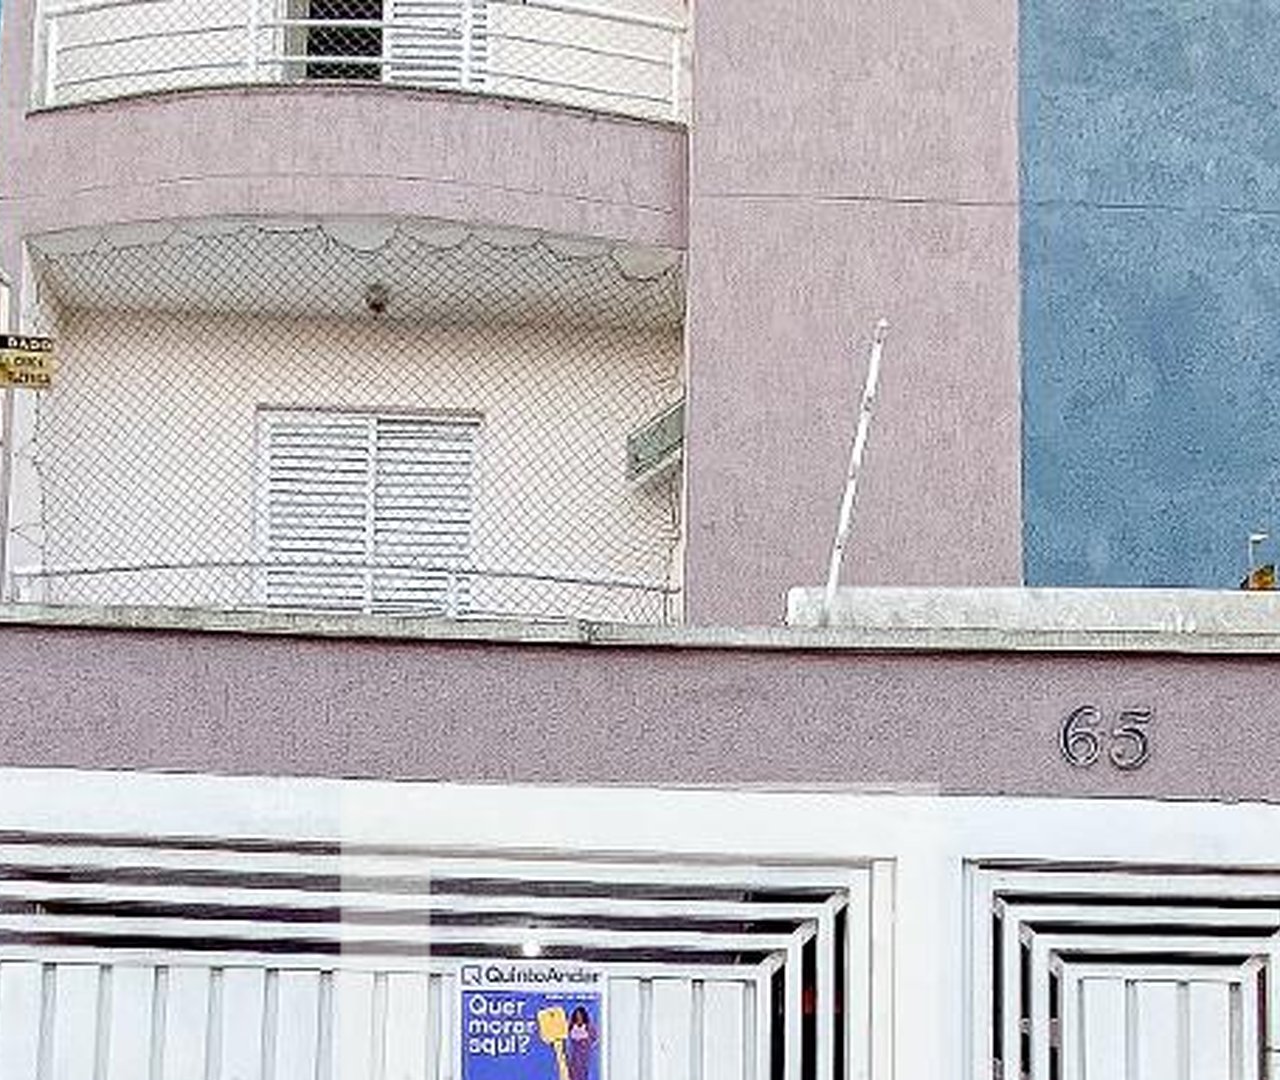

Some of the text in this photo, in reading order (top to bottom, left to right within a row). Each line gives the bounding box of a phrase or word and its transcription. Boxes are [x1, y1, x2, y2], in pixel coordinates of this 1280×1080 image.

[1059, 705, 1152, 770] 65
[485, 966, 600, 984] QuintoAndar
[469, 994, 526, 1015] Quer
[469, 1019, 537, 1035] morar
[469, 1036, 530, 1056] aqui?
